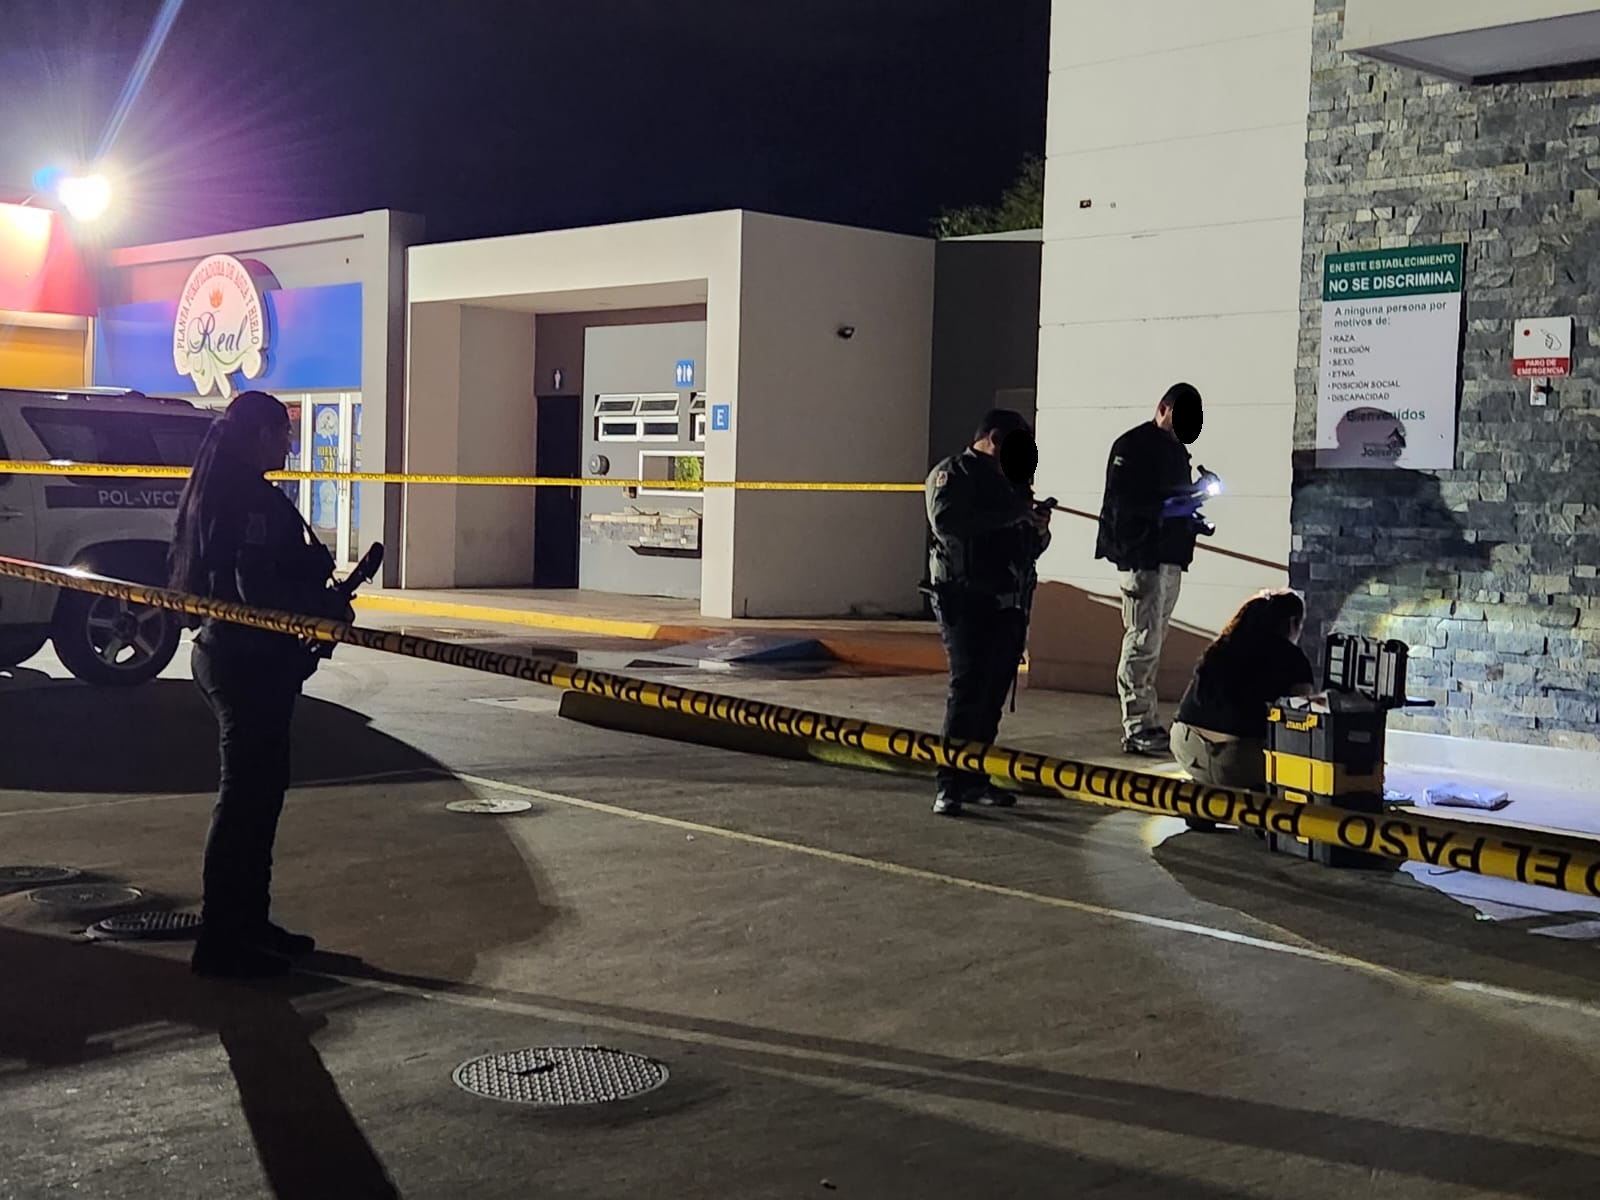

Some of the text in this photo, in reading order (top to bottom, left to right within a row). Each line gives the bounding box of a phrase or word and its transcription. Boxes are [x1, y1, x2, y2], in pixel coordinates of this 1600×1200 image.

[1329, 253, 1456, 273] EN ESTE ESTABLECIMIENTO
[1328, 270, 1455, 293] NO SE DISCRIMINA
[1334, 301, 1447, 317] A ninguna persona por
[1334, 315, 1391, 328] motivos de:
[177, 306, 190, 348] PLANTA
[248, 305, 260, 345] HIELO
[187, 311, 248, 354] Real
[1332, 358, 1354, 366] SEXO
[1370, 380, 1401, 388] SOCIAL
[717, 408, 725, 427] E
[571, 669, 645, 702] PASO
[690, 692, 867, 748] PROHIBIDO
[889, 728, 1305, 836] PROHIBIDO EL PASO
[1338, 816, 1486, 873] PASO
[1502, 842, 1571, 891] EL
